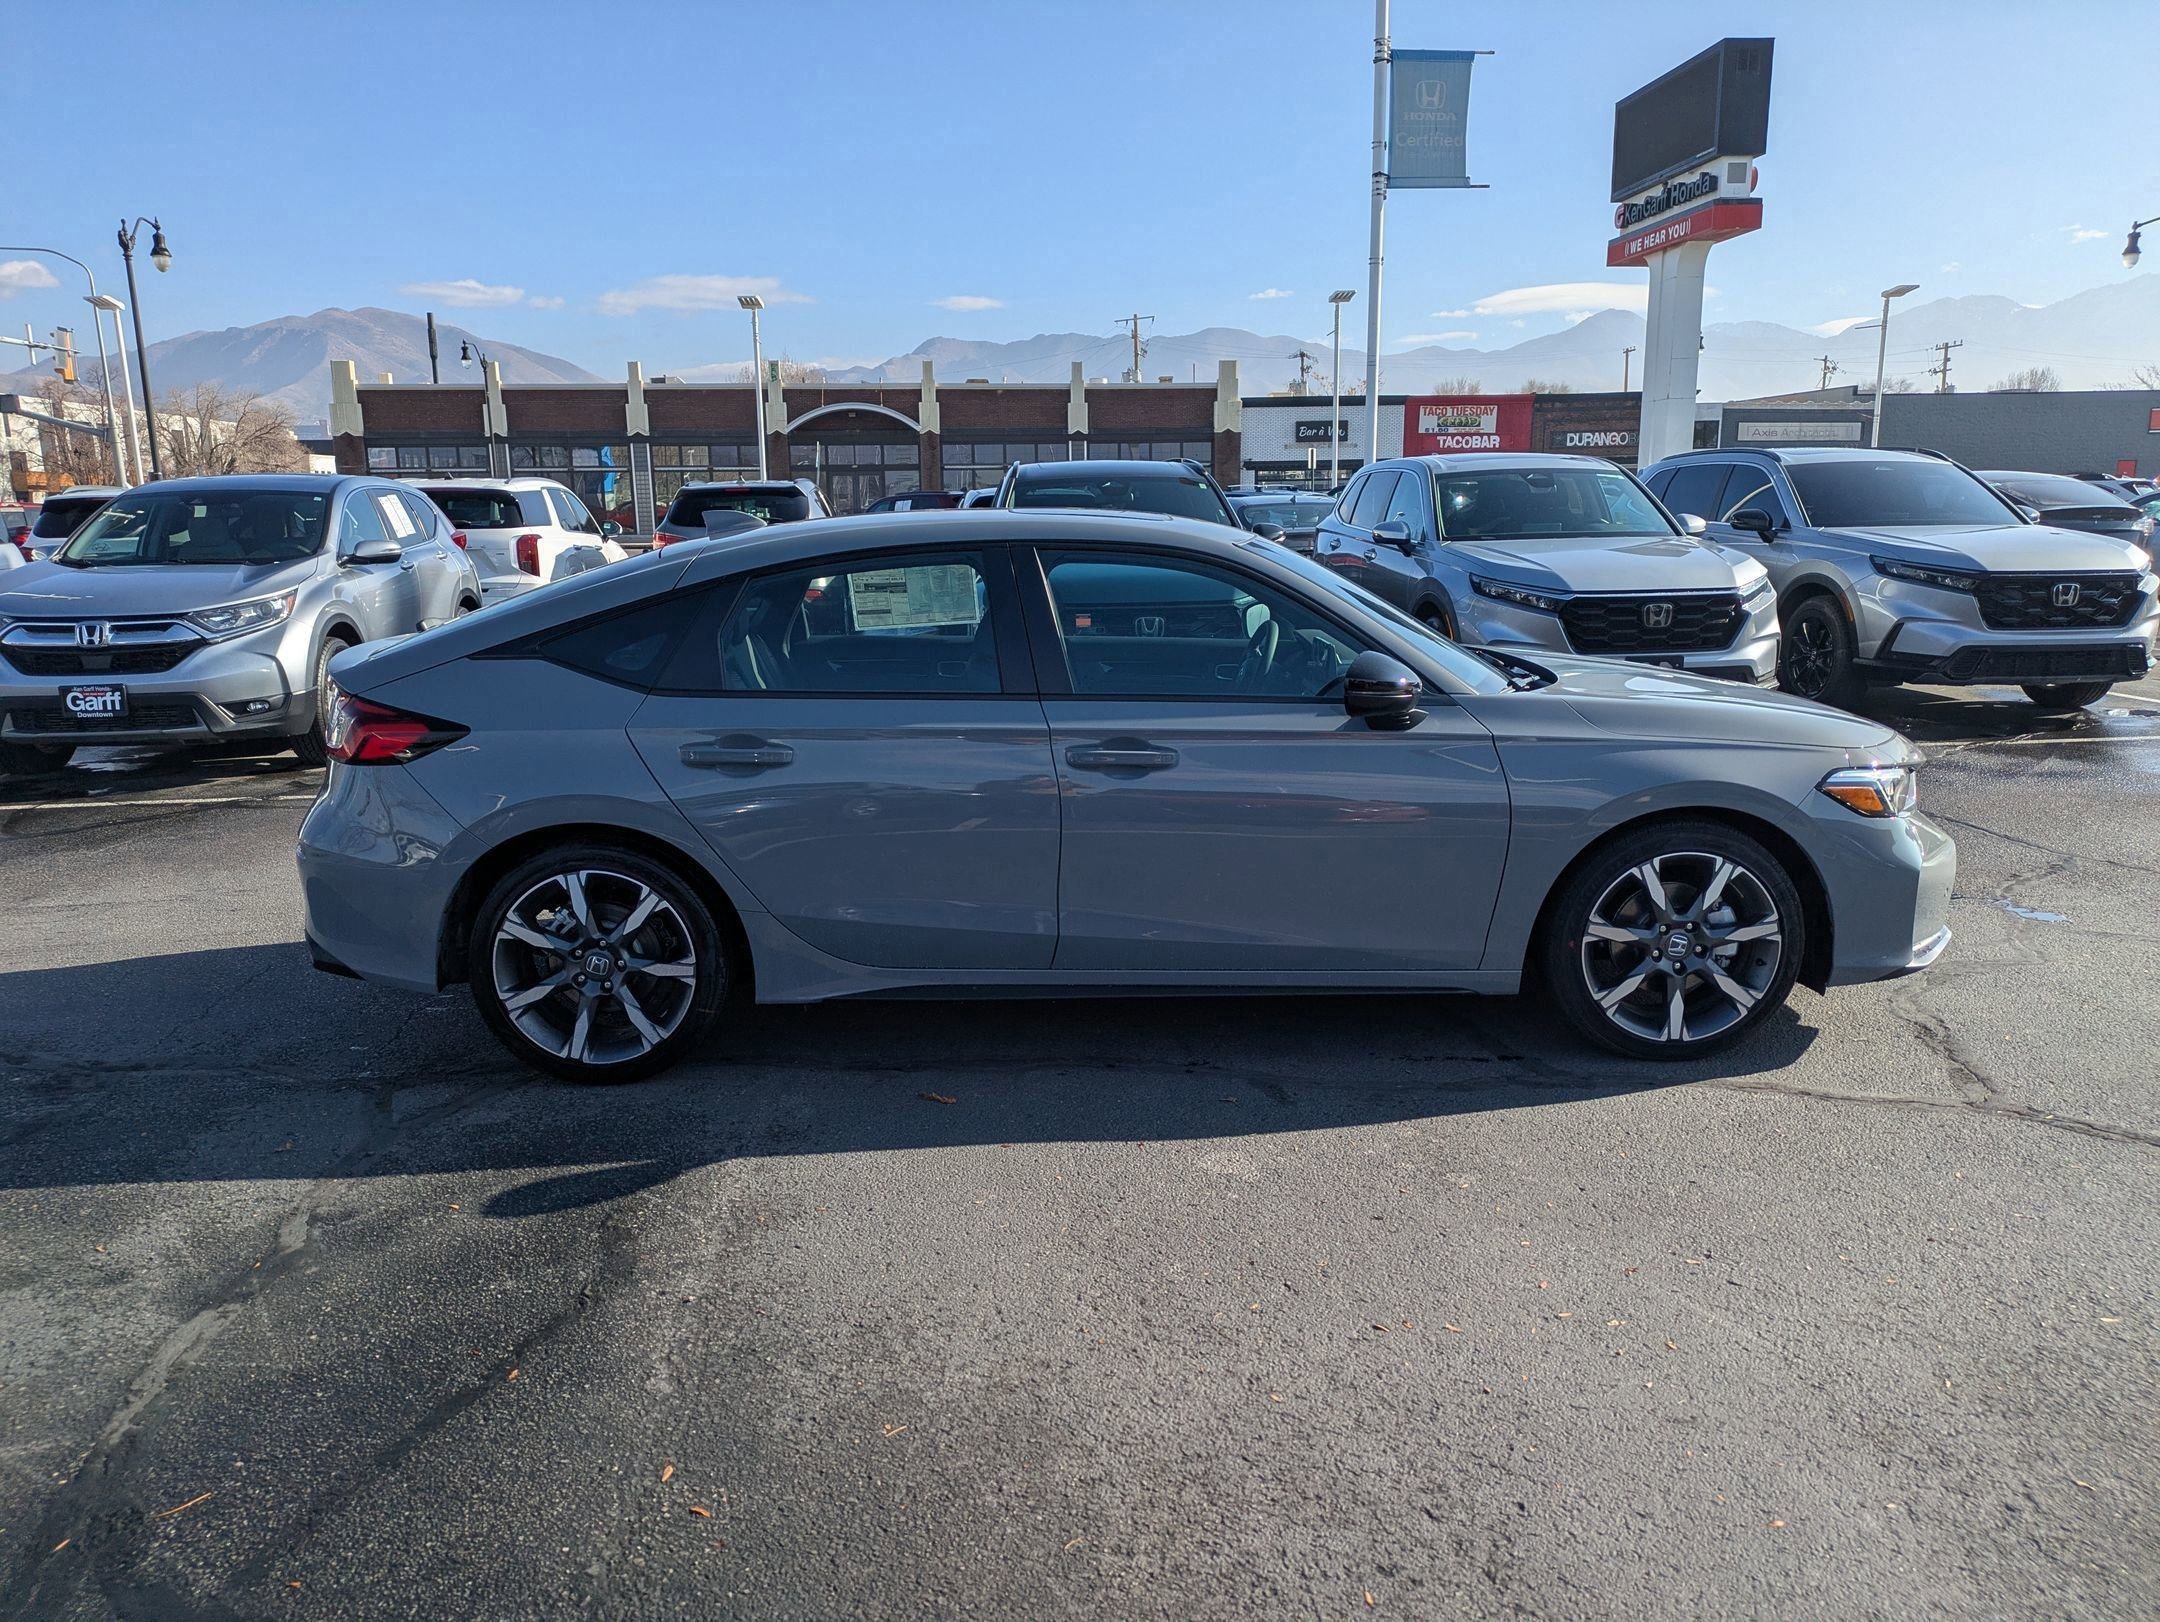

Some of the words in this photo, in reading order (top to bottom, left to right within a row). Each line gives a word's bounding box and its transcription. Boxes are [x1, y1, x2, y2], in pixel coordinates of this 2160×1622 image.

[1403, 112, 1457, 121] HONDA
[1396, 131, 1464, 147] Certified
[1670, 173, 1711, 207] Honda
[1630, 239, 1642, 254] WE
[1644, 229, 1666, 250] HEAR
[1668, 221, 1686, 240] YOU
[1422, 406, 1448, 417] TACO
[1450, 406, 1496, 417] TUESDAY
[1299, 426, 1317, 437] Bar
[1752, 428, 1778, 437] Axis
[1436, 435, 1501, 449] TACOBAR
[66, 691, 121, 711] Garff
